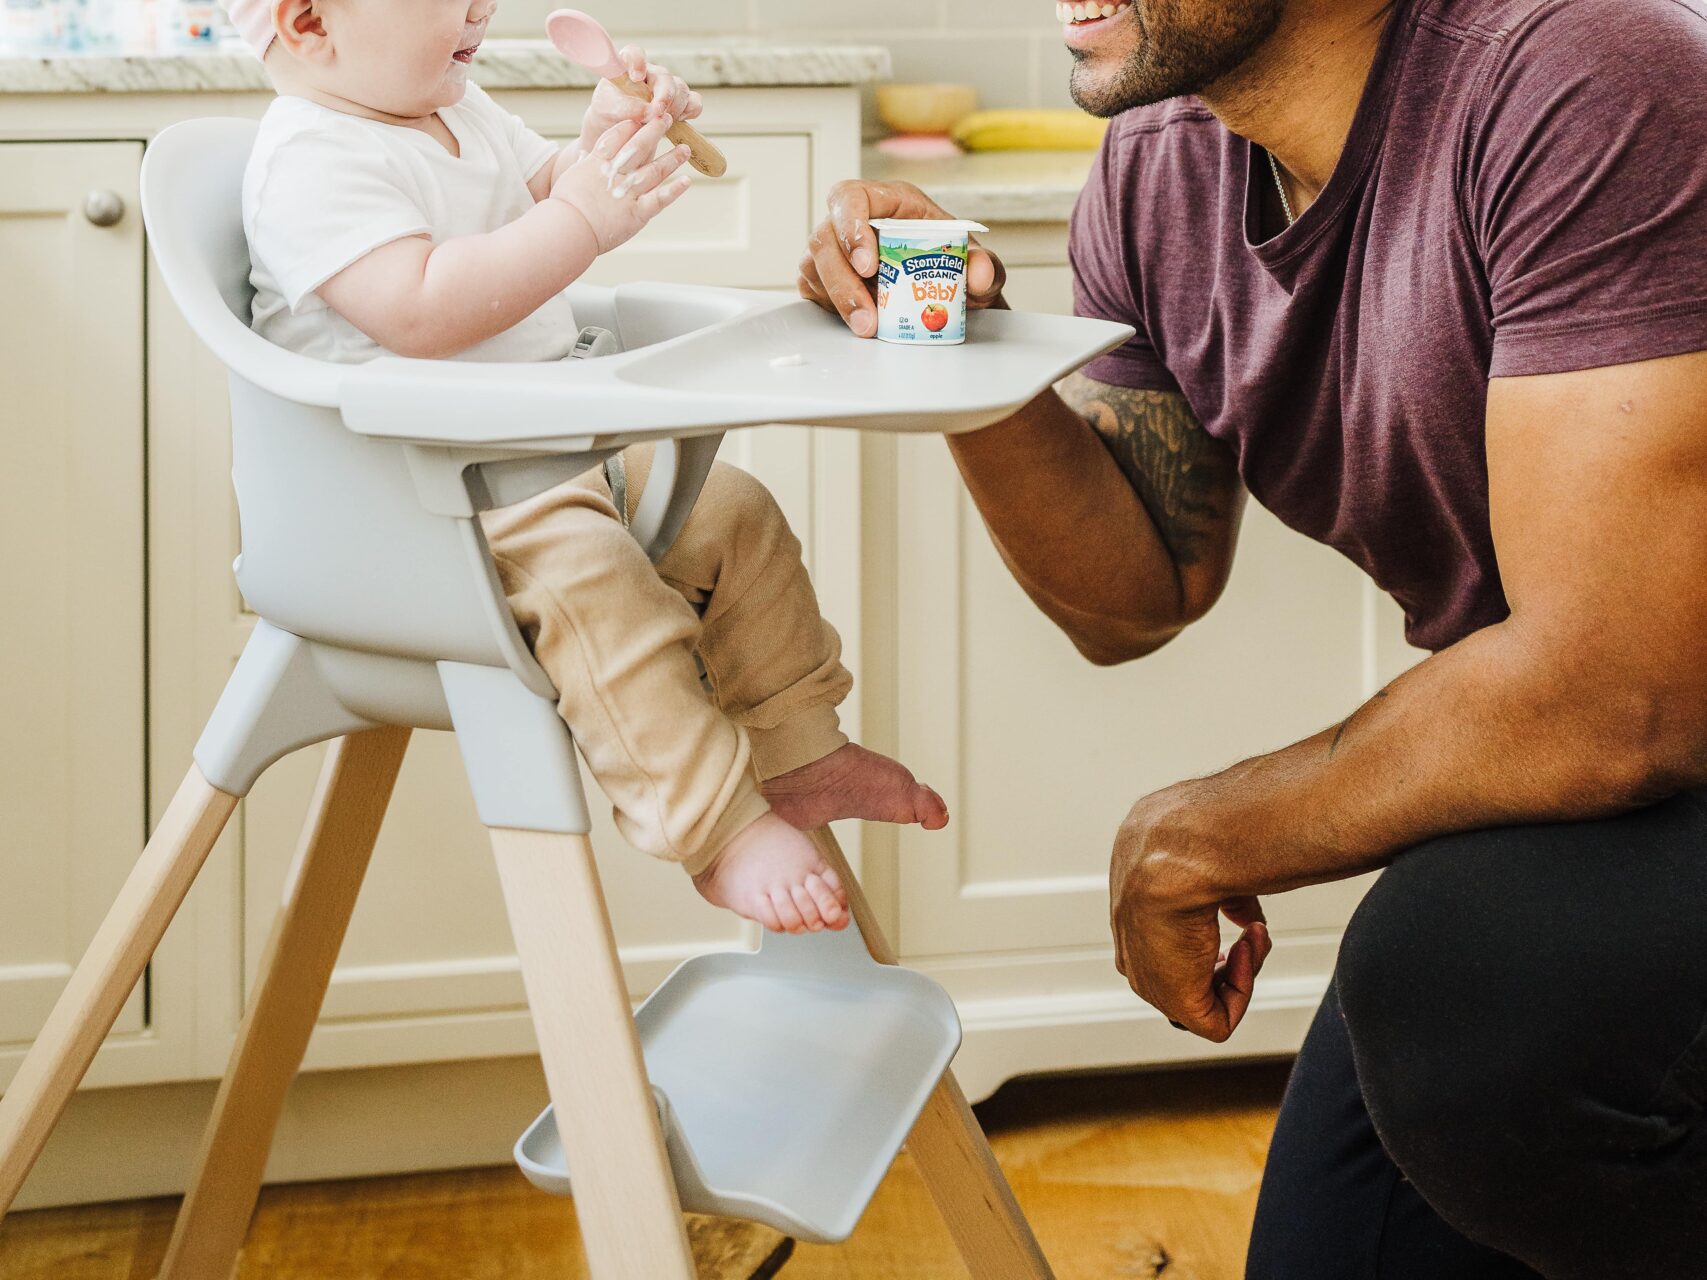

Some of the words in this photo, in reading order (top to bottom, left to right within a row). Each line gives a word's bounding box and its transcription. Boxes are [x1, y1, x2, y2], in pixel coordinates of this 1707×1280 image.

[906, 255, 963, 272] Stonyfield
[914, 270, 958, 281] ORGANIC
[912, 282, 958, 302] baby
